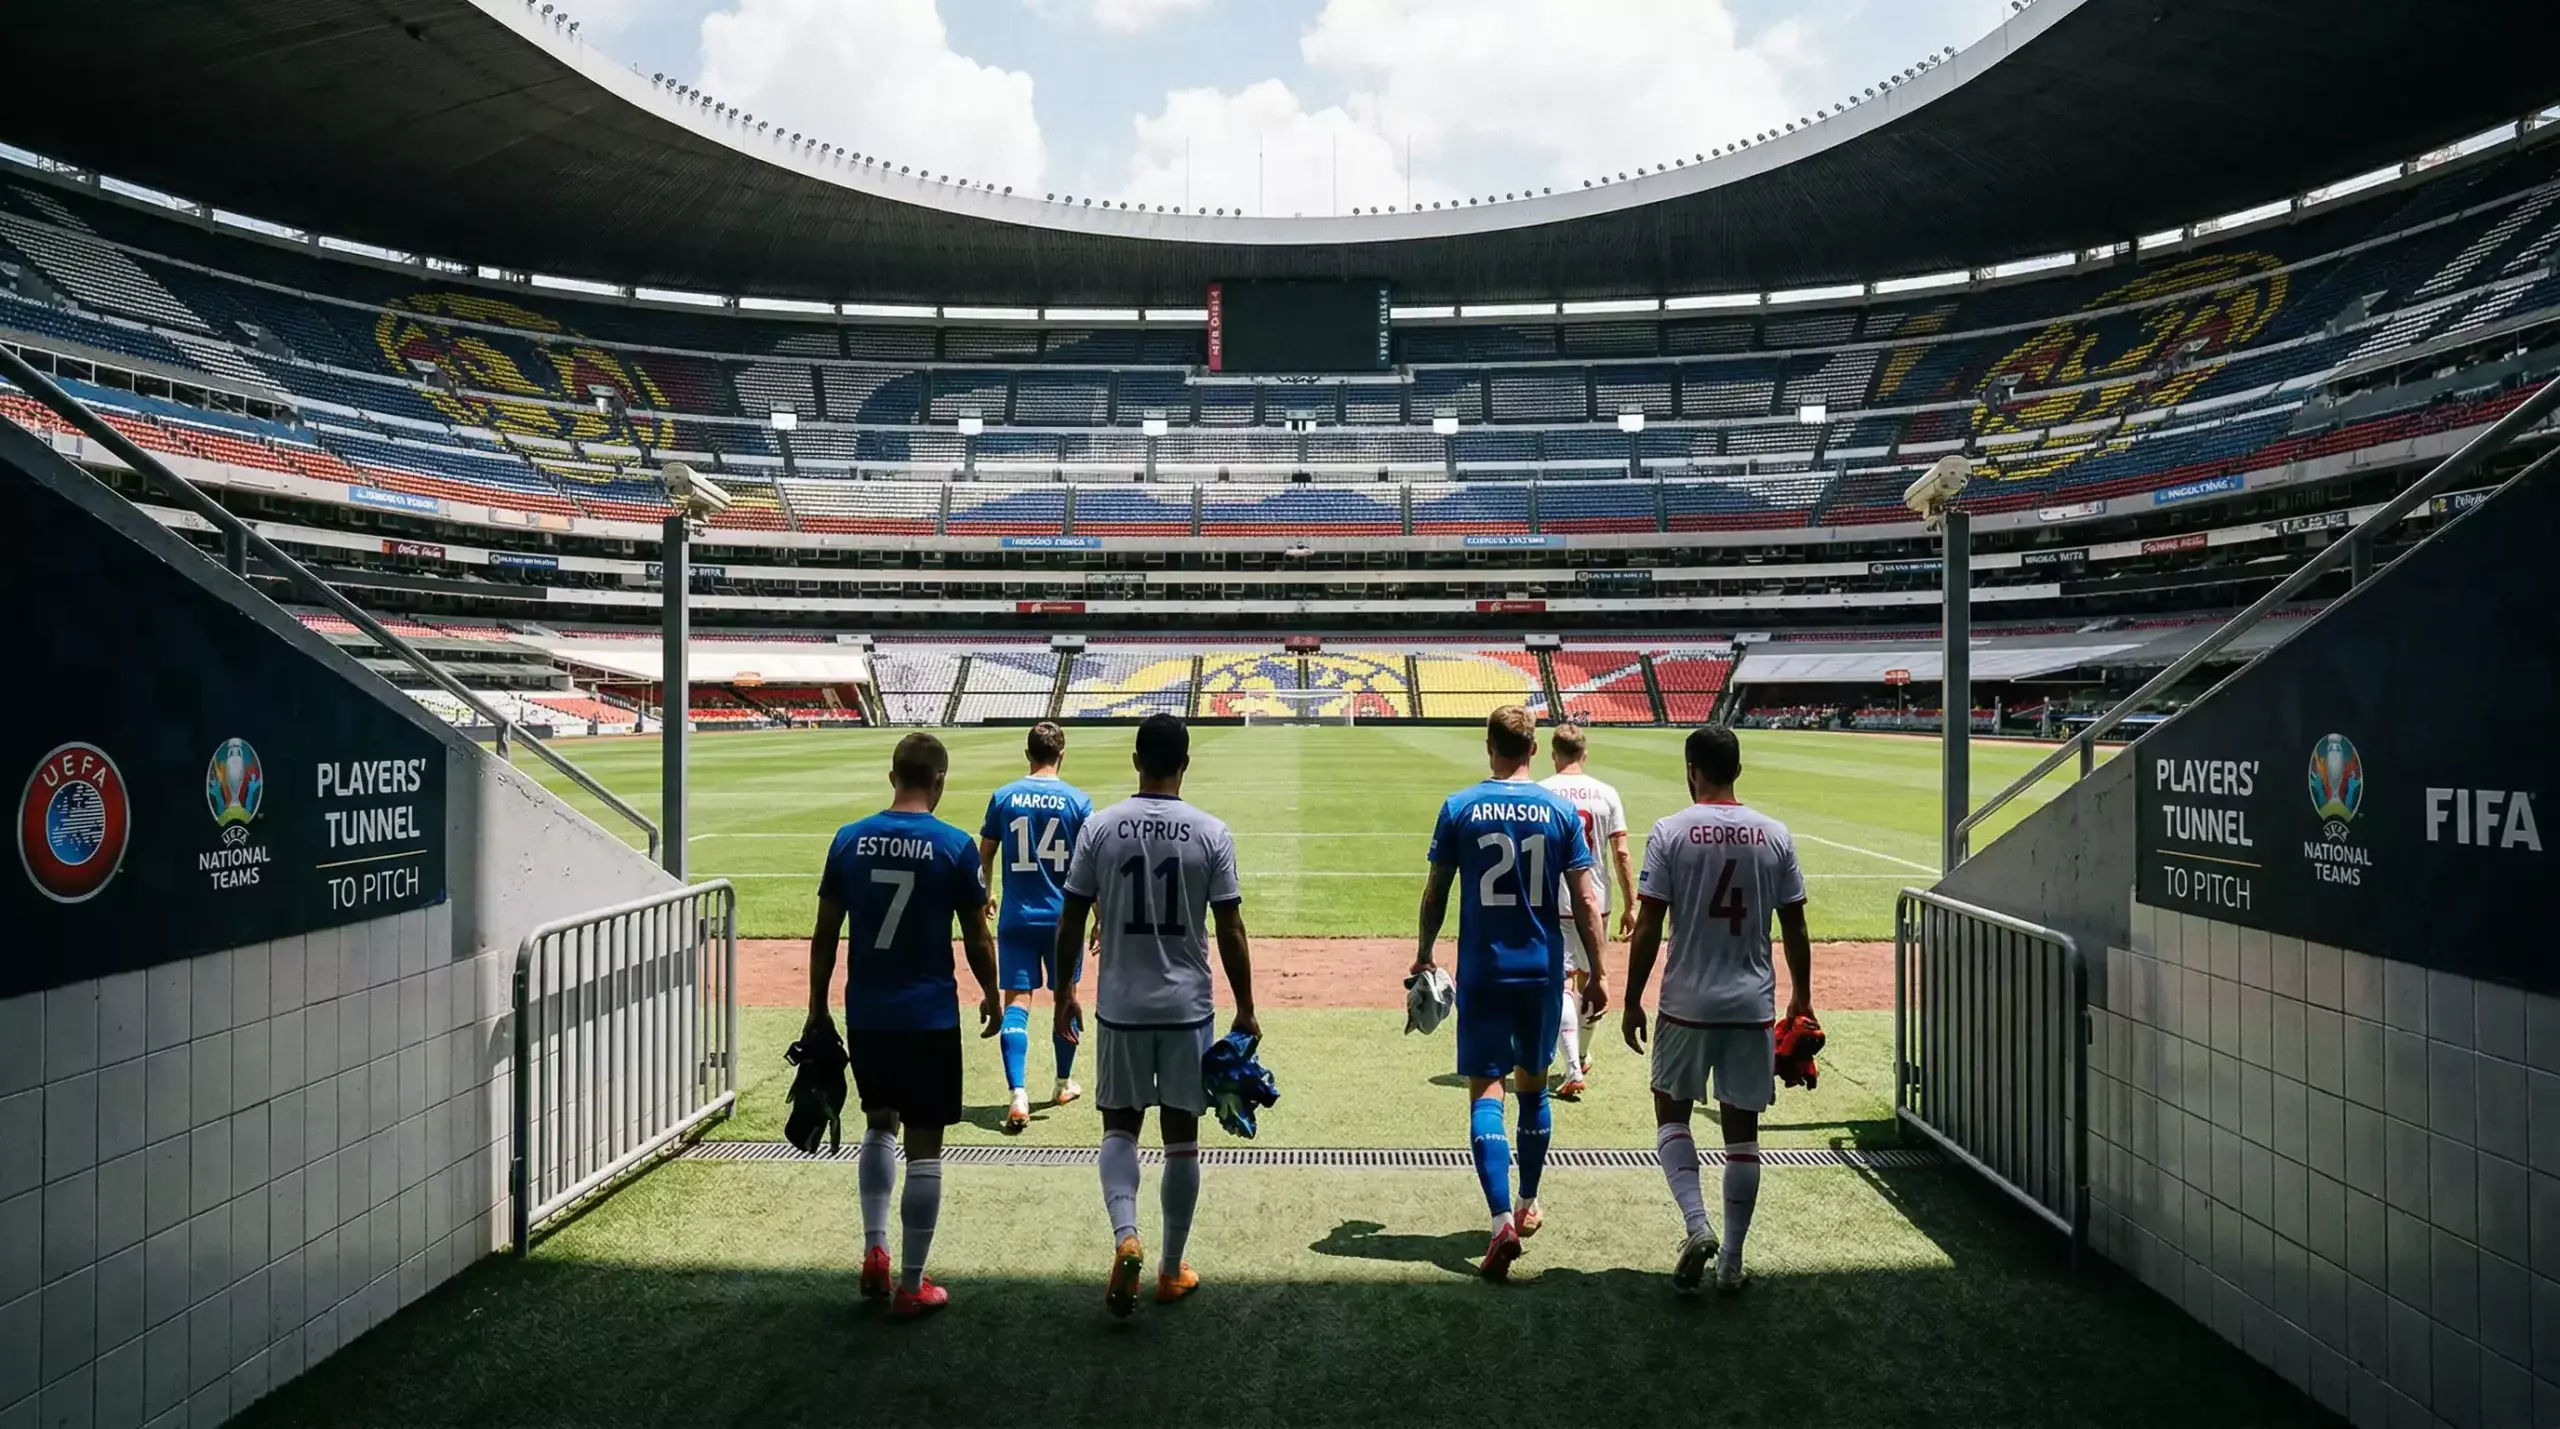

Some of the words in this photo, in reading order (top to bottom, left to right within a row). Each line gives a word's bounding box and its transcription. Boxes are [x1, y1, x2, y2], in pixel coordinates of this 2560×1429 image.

[43, 755, 108, 788] UEFA
[317, 758, 426, 797] PLAYERS'
[2156, 758, 2259, 796] PLAYERS'
[1011, 793, 1066, 810] MARCOS
[1551, 787, 1601, 800] ORGIA
[325, 805, 421, 848] TUNNEL
[1117, 819, 1191, 843] CYPRUS
[1471, 803, 1551, 824] ARNASON
[2162, 805, 2253, 847] TUNNEL
[2425, 787, 2543, 851] FIFA
[222, 828, 247, 844] UEFA
[856, 836, 934, 860] ESTONIA
[1010, 815, 1069, 872] 14
[1689, 825, 1767, 846] GEORGIA
[199, 845, 272, 870] NATIONAL
[1477, 832, 1546, 907] 21
[2303, 841, 2373, 866] NATIONAL
[210, 866, 261, 890] TEAMS
[328, 876, 357, 910] TO
[363, 865, 419, 905] PITCH
[2163, 865, 2188, 898] TO
[2194, 870, 2251, 910] PITCH
[2313, 862, 2361, 886] TEAMS
[870, 869, 915, 949] 7
[1120, 855, 1186, 936] 11
[1708, 859, 1748, 937] 4
